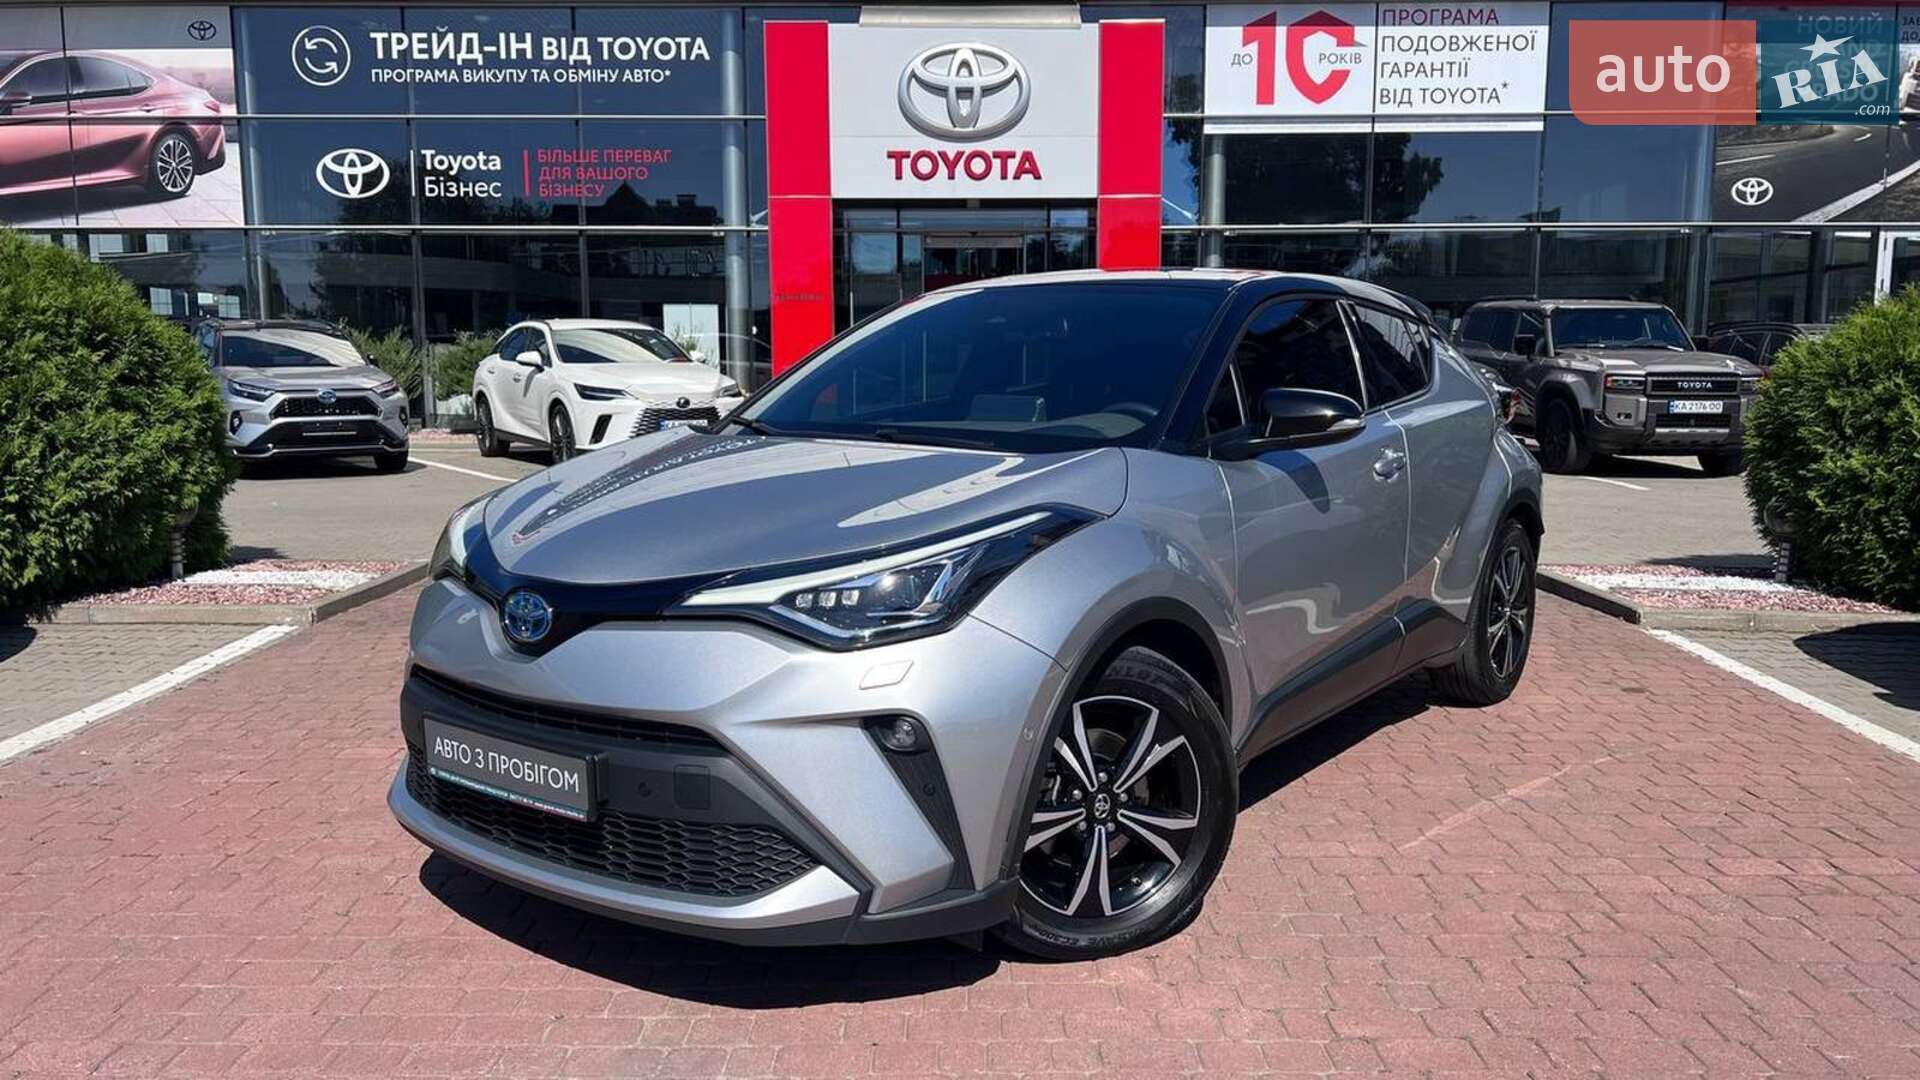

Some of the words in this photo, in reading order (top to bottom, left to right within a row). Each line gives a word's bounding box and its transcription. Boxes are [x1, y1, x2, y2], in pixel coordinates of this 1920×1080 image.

[1382, 8, 1500, 26] ПРОГРАМА
[369, 25, 533, 66] ТРЕЙД-ІН
[541, 36, 593, 66] ВІД
[597, 36, 711, 61] TOYOTA
[1380, 30, 1538, 55] ПОДОВЖЕНОЇ
[1230, 53, 1254, 67] ДО
[1318, 53, 1363, 66] РОКІВ
[1380, 57, 1471, 79] ГАРАНТІЇ
[371, 68, 459, 83] ПРОГРАМА
[463, 68, 528, 83] ВИКУПУ
[530, 69, 551, 82] ТА
[553, 68, 619, 83] ОБМІНУ
[1379, 88, 1412, 107] ВІД
[420, 149, 502, 176] Toyota
[537, 149, 600, 163] БІЛЬШЕ
[603, 149, 672, 163] ПЕРЕВАГ
[886, 149, 1043, 182] TOYOTA
[538, 166, 572, 181] ДЛЯ
[575, 166, 649, 180] ВАШОГО
[424, 176, 503, 198] Бізнес
[538, 183, 605, 198] БІЗНЕСУ
[1677, 381, 1712, 389] TOYOTA
[434, 735, 471, 764] АВТО
[474, 748, 485, 769] З
[488, 752, 580, 793] ПРОБІГОМ
